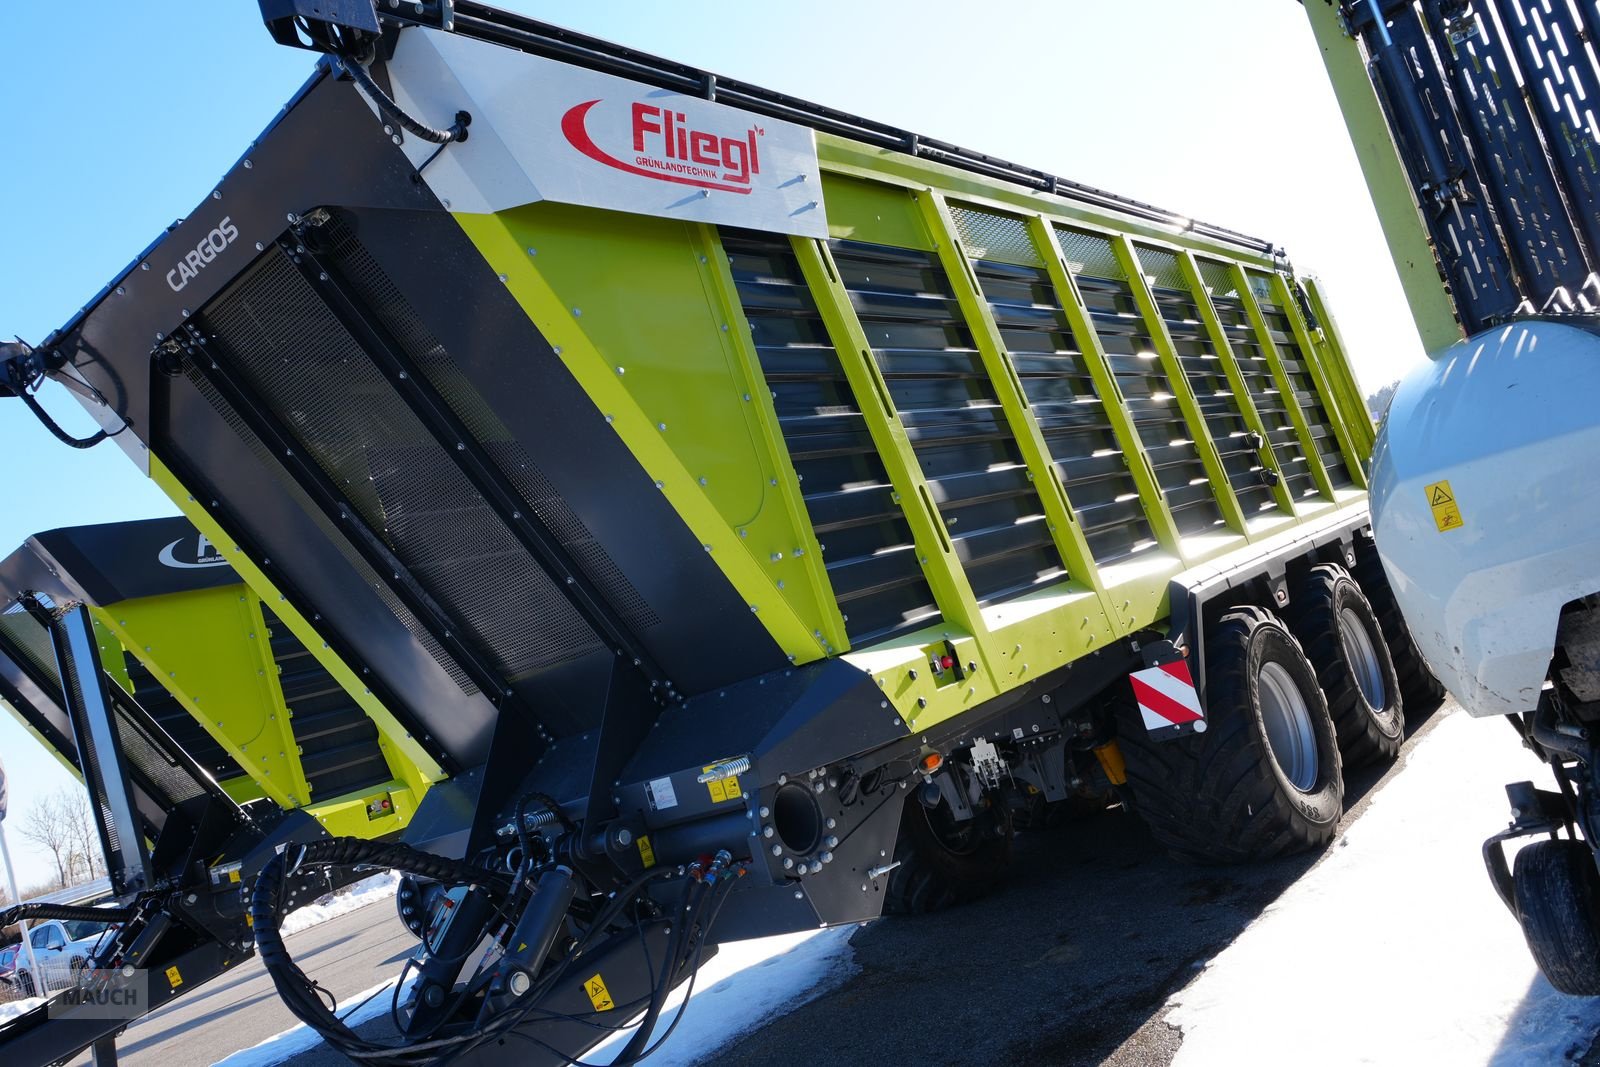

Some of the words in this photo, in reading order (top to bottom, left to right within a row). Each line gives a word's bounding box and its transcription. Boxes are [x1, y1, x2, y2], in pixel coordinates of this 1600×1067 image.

[632, 102, 760, 184] Fliegl
[636, 156, 717, 179] GRÜNLANDTECHNIK
[166, 216, 239, 292] CARGOS
